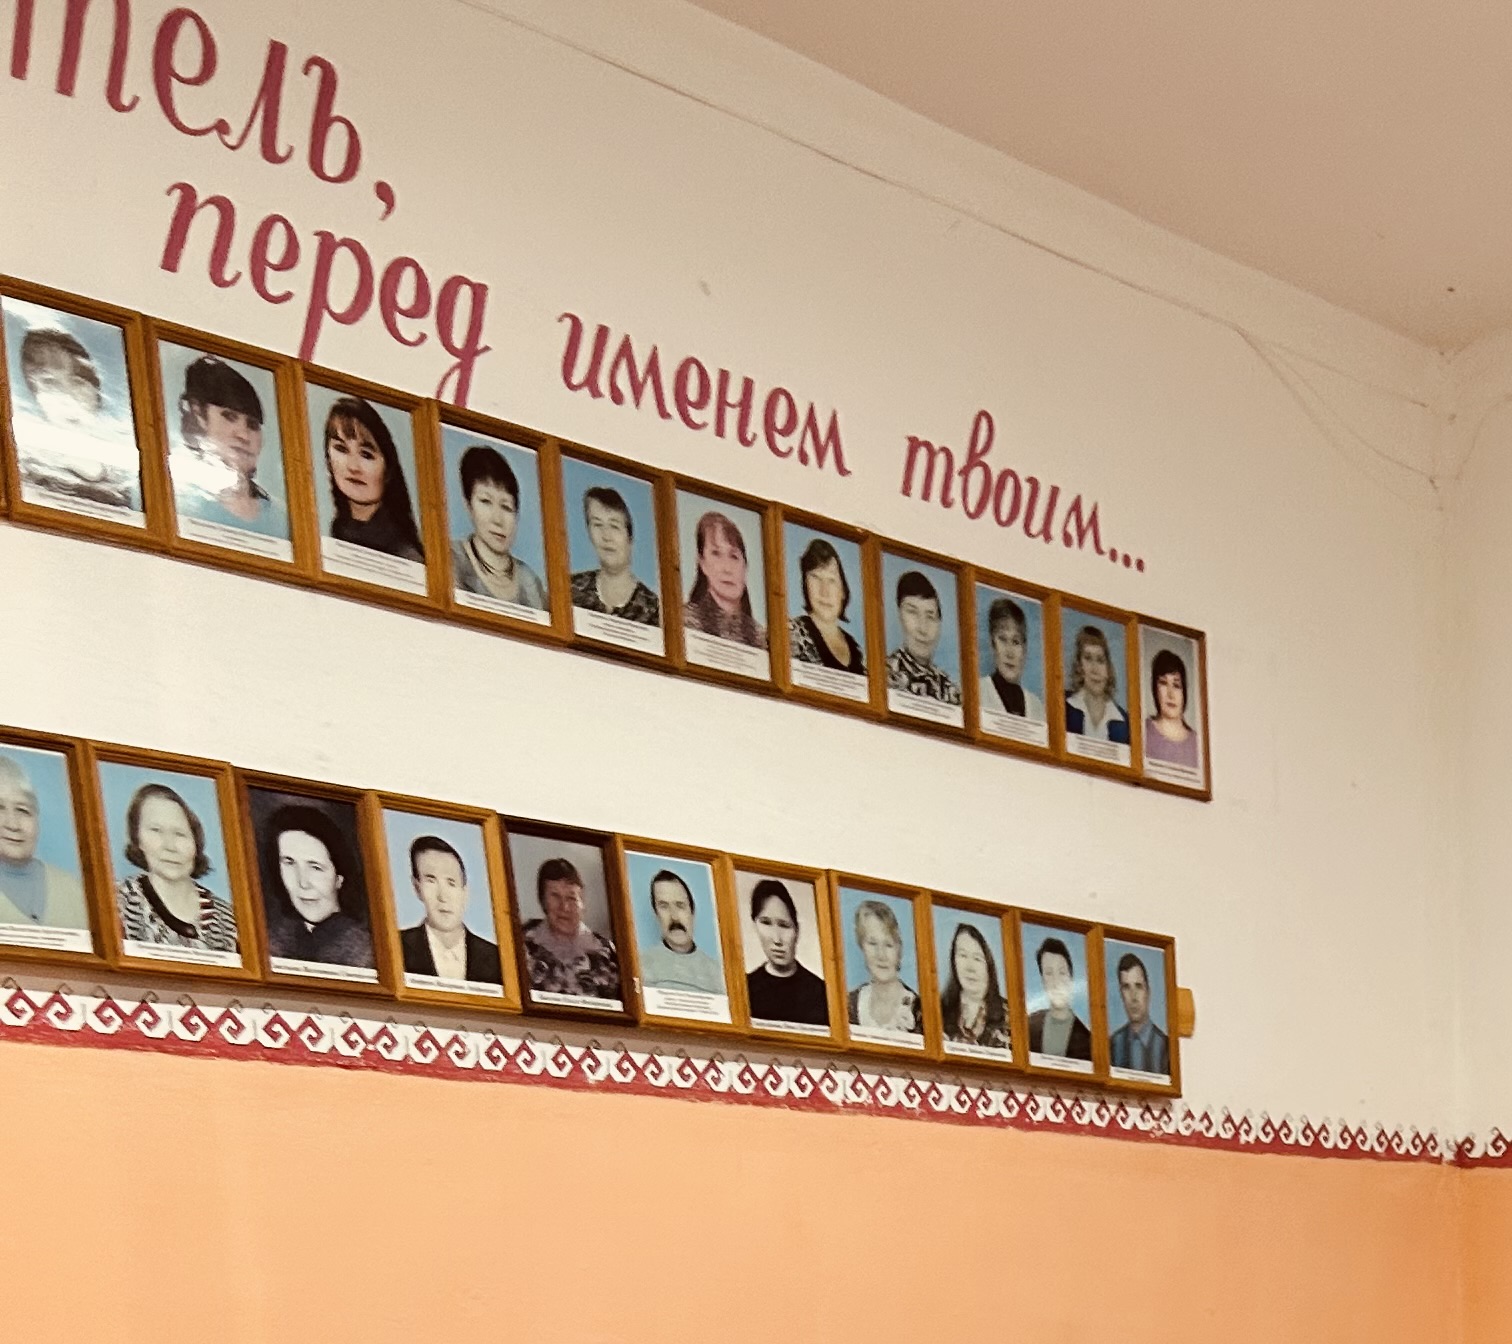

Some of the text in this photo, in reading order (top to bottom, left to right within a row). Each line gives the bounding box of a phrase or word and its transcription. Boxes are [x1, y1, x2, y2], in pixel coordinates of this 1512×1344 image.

[159, 182, 1146, 573] перед именем твоим...
